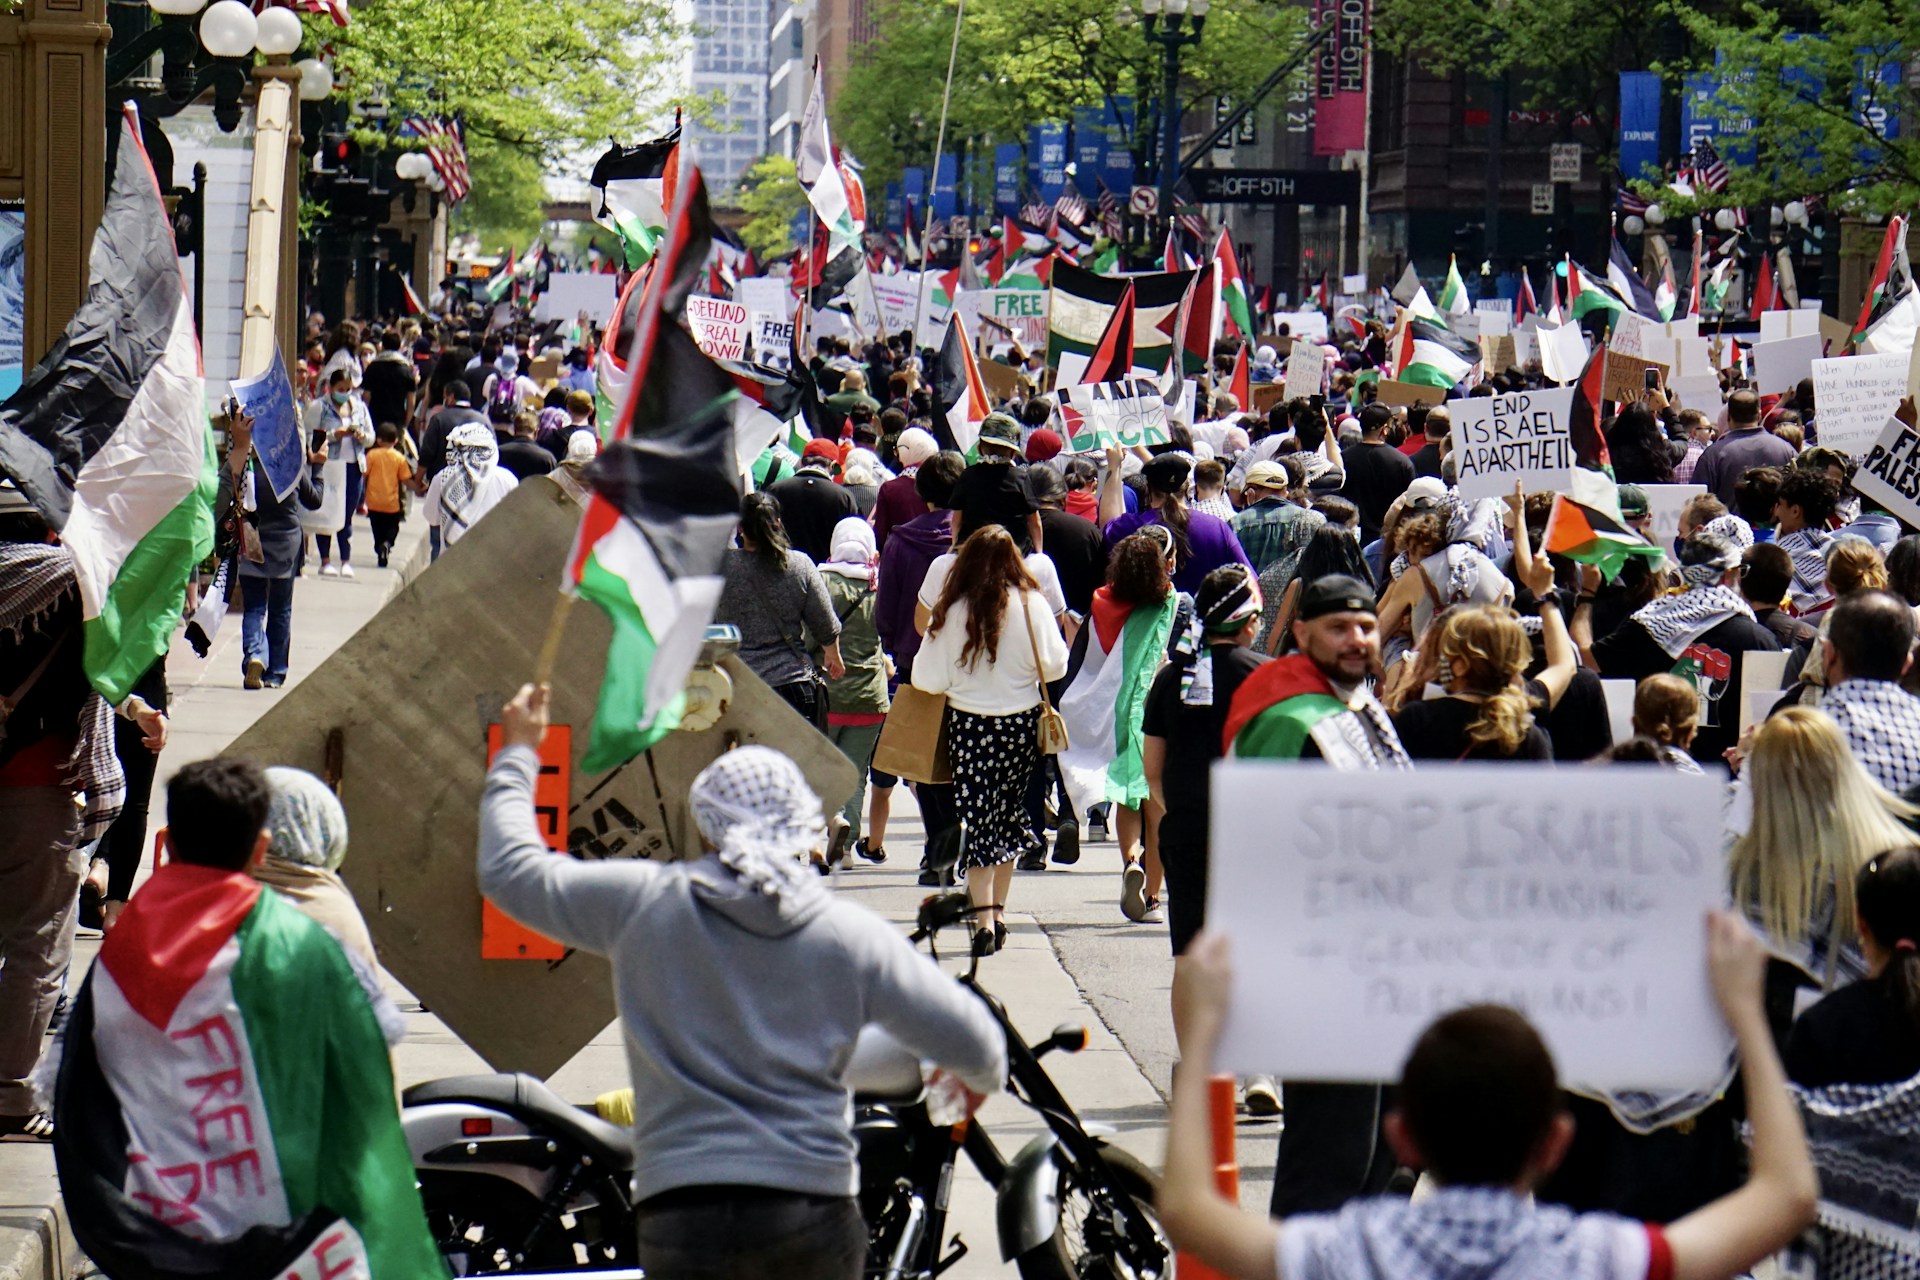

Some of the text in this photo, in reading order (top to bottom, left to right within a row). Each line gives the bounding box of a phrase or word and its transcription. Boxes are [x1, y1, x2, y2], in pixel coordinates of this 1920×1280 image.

[1340, 0, 1365, 91] OFF 5TH
[1287, 112, 1308, 133] 21
[1226, 177, 1259, 195] OFF
[1261, 177, 1294, 196] 5TH
[692, 300, 746, 324] DEFUND
[994, 294, 1043, 316] FREE
[697, 321, 741, 343] SREAL
[760, 337, 791, 348] PALEST
[762, 321, 792, 339] FRE
[1057, 378, 1163, 417] LAND
[1493, 395, 1531, 417] END
[1066, 410, 1169, 452] BACK
[1462, 412, 1567, 443] ISRAEL
[1891, 428, 1920, 470] FR
[1863, 444, 1920, 506] PALES
[1295, 793, 1443, 863] STOP
[171, 1013, 265, 1198] FREE
